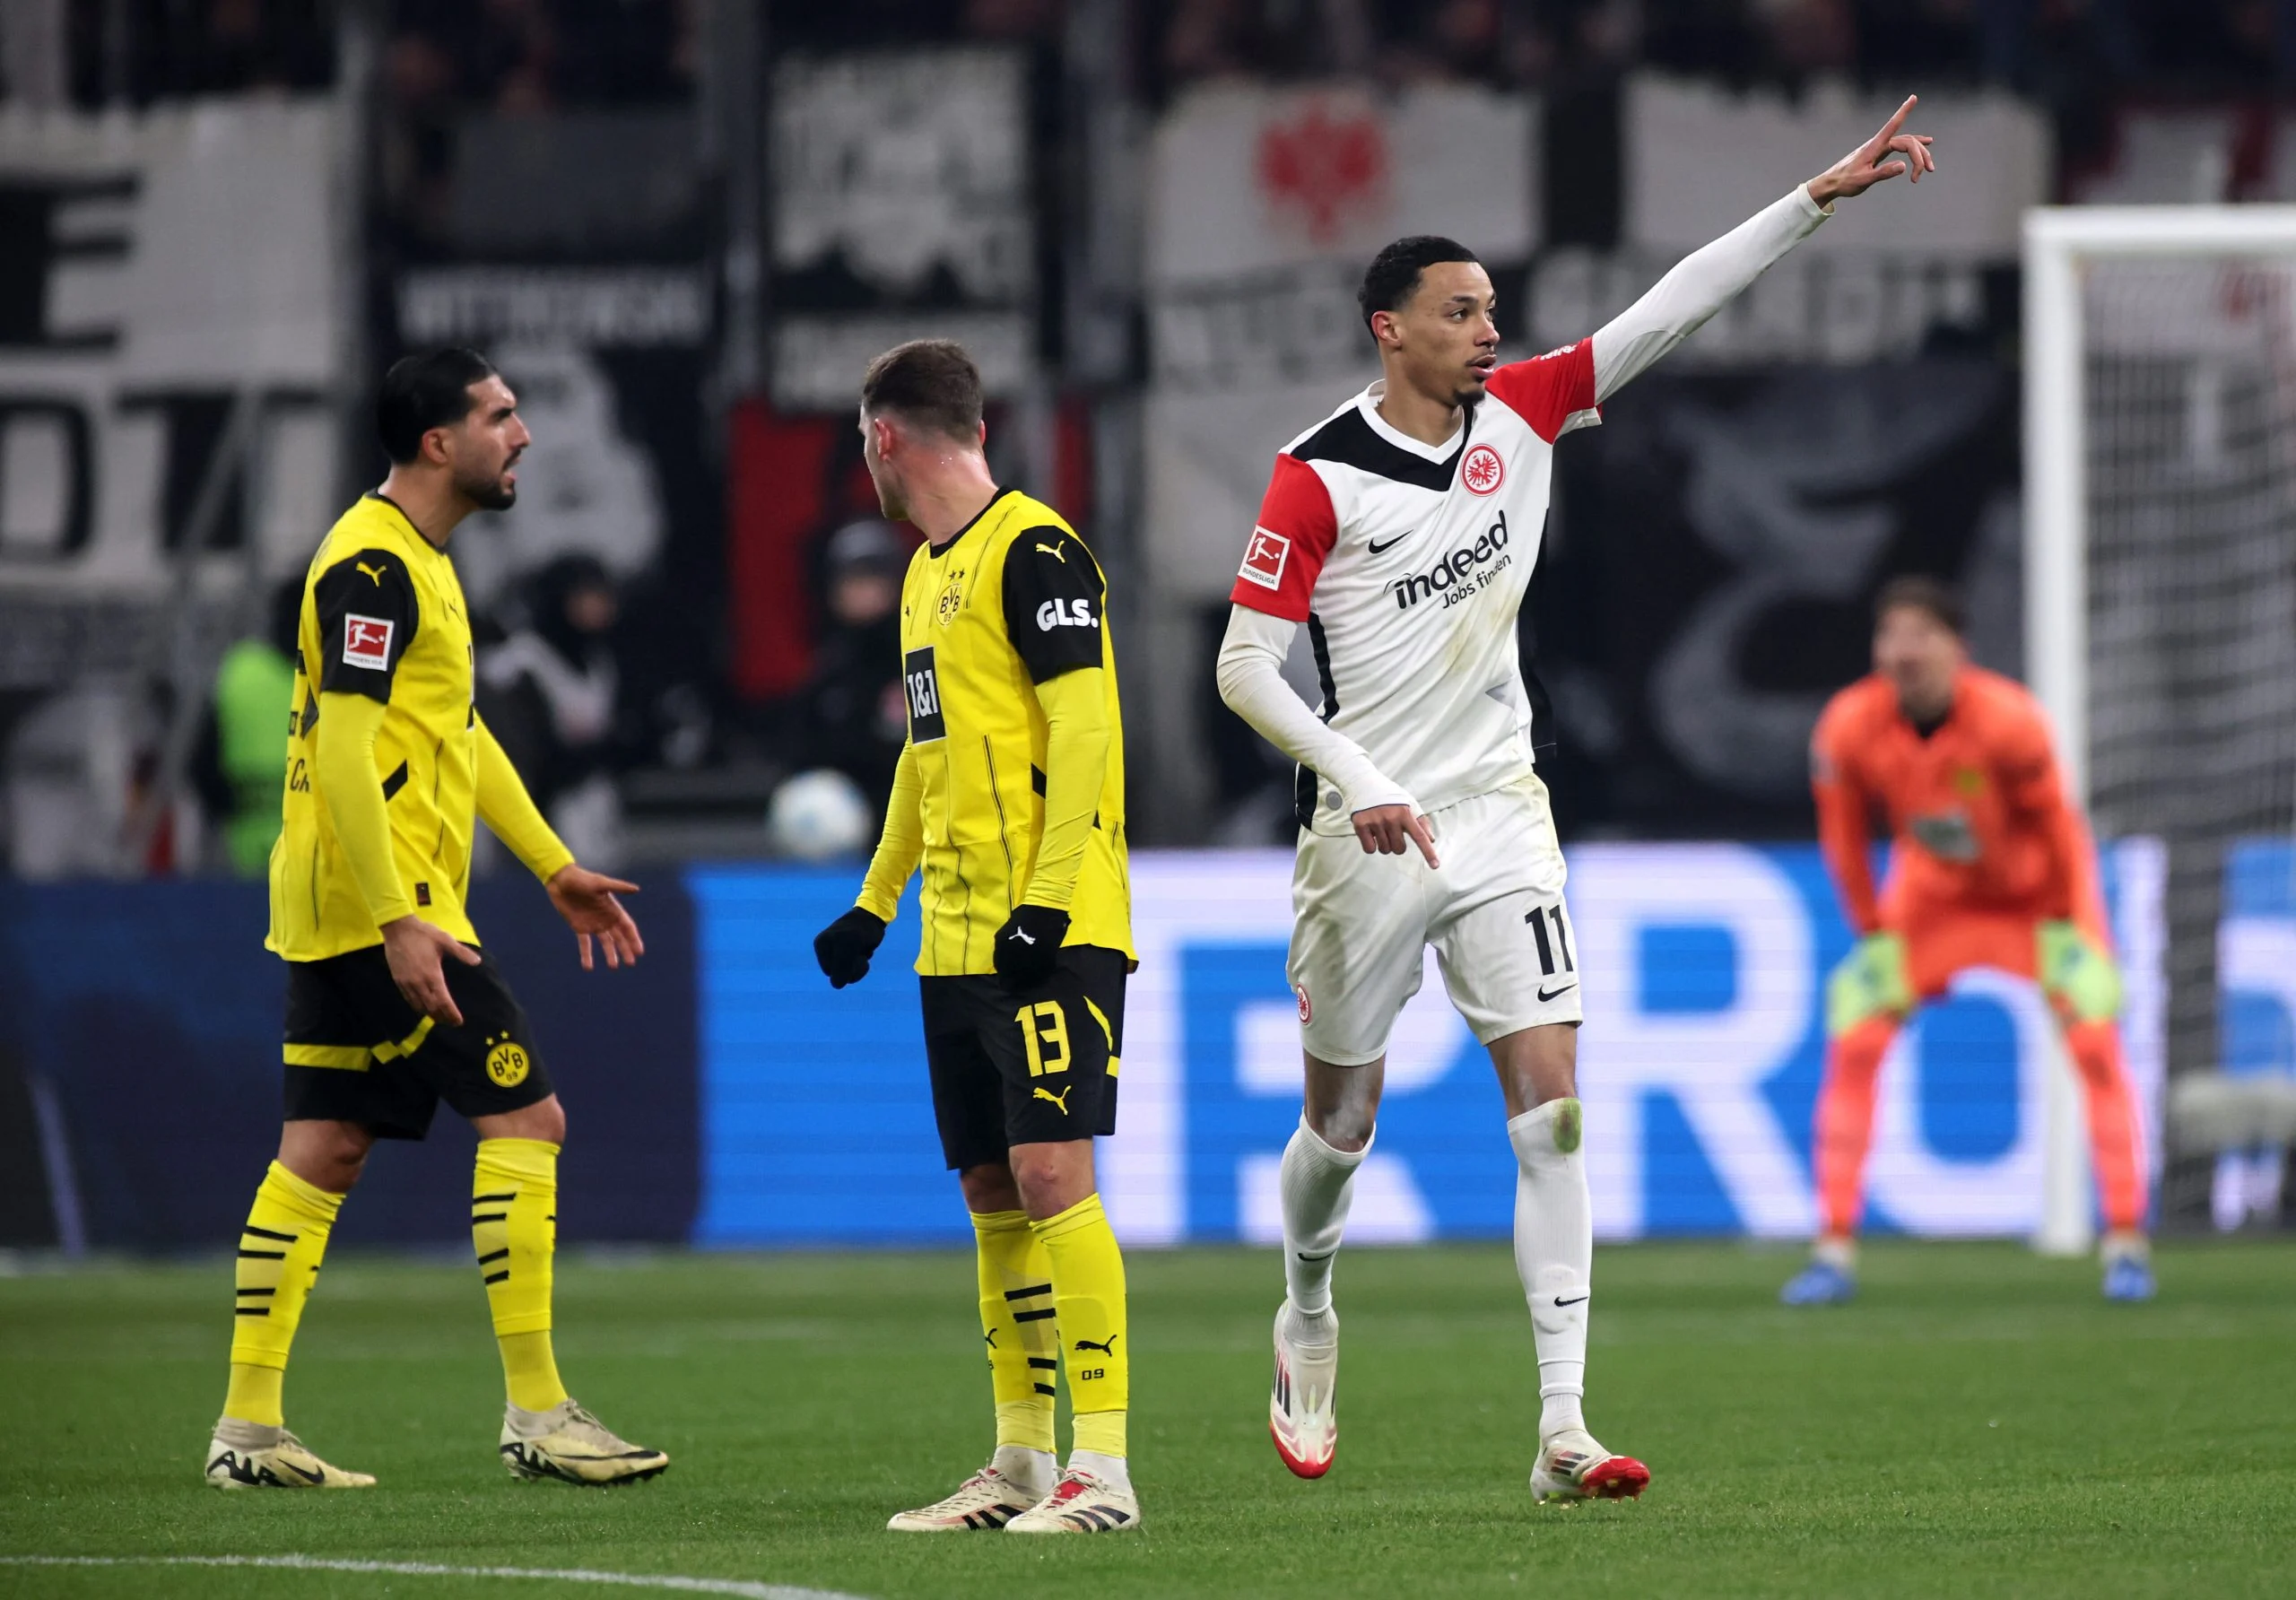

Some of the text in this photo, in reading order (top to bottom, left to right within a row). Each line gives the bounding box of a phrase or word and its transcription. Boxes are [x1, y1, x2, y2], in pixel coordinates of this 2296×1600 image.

[1242, 567, 1275, 585] BUNDESLIGA
[1395, 509, 1509, 609] indeed
[1442, 554, 1512, 609] Jobs finden
[939, 587, 960, 613] BVB
[907, 669, 938, 718] 1&1
[1525, 904, 1574, 976] 11
[491, 1048, 523, 1077] BVB
[1014, 1000, 1071, 1077] 13
[1082, 1369, 1104, 1380] 09
